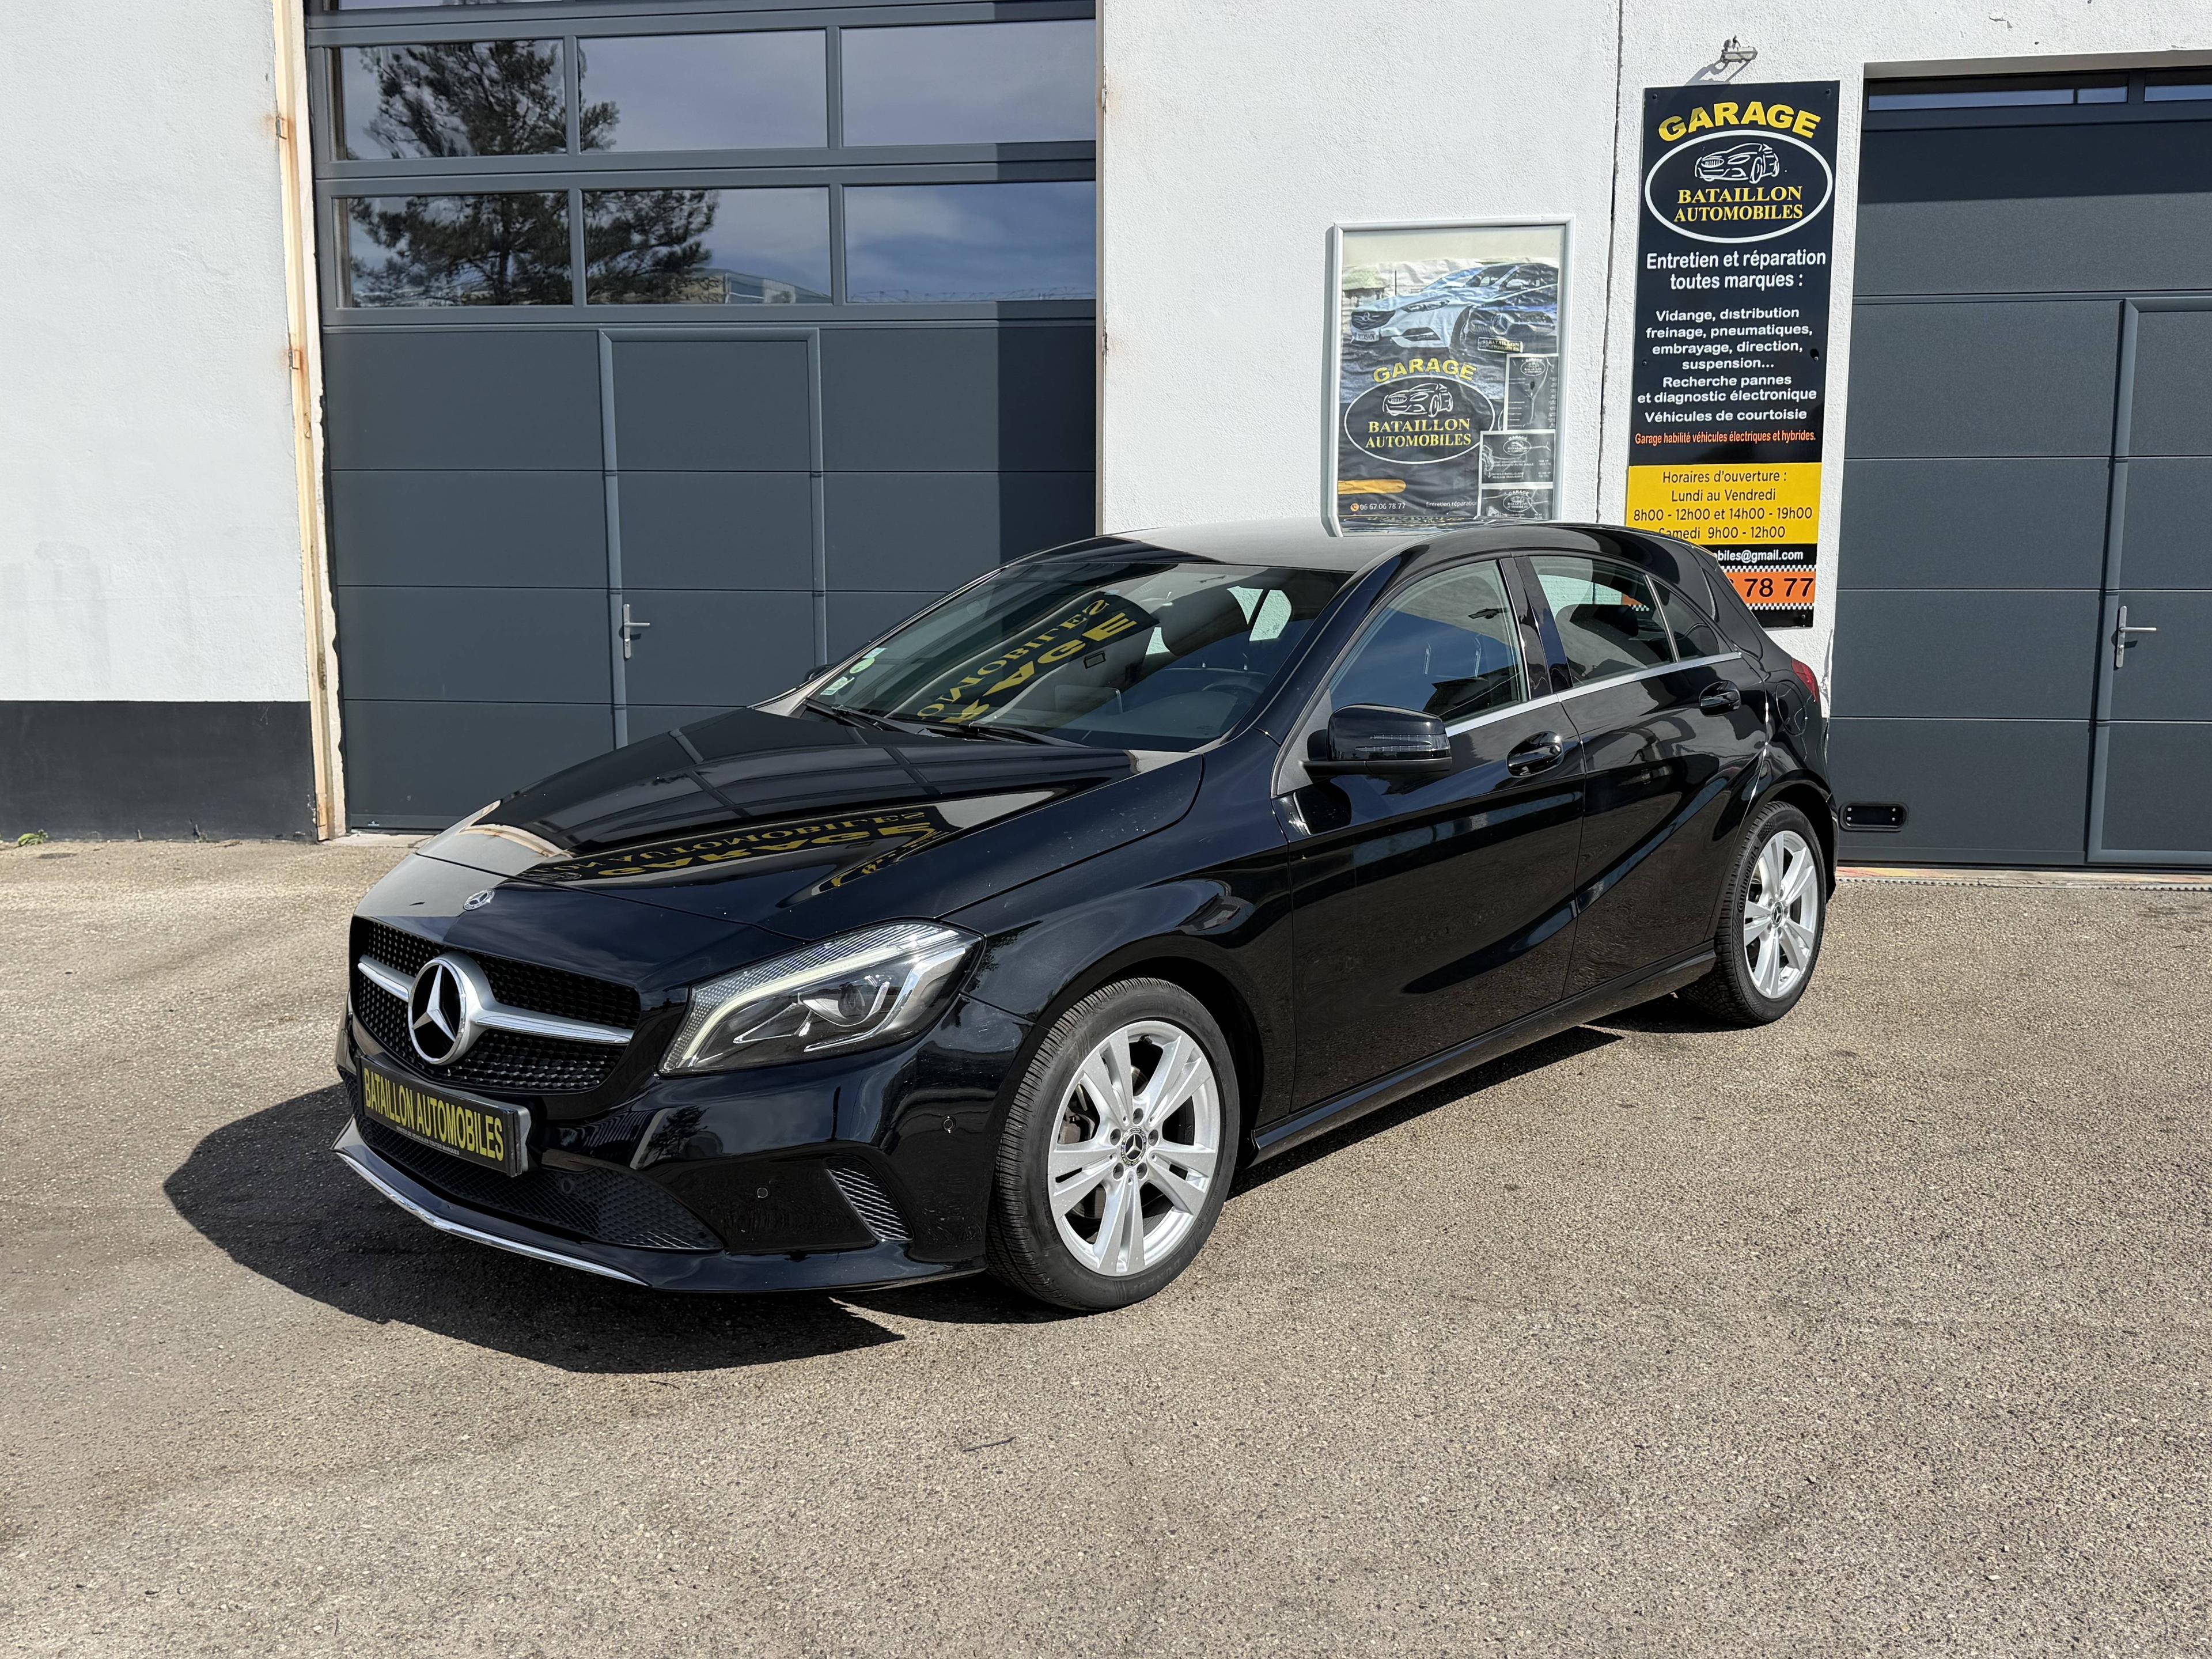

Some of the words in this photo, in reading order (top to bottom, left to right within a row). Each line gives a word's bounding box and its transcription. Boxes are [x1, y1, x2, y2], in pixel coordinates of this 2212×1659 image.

[1658, 101, 1821, 142] GARAGE
[1677, 186, 1803, 204] BATAILLON
[1673, 204, 1803, 222] AUTOMOBILES
[1646, 252, 1719, 270] Entretien
[1723, 251, 1740, 267] et
[1743, 249, 1827, 270] réparation
[1670, 273, 1720, 290] toutes
[1724, 273, 1794, 291] marques
[1656, 310, 1716, 323] Vidange,
[1719, 307, 1800, 320] distribution
[1645, 327, 1707, 340] freinage,
[1710, 324, 1813, 339] pneumatiques,
[1652, 343, 1733, 356] embrayage,
[1736, 340, 1803, 353] direction,
[1373, 358, 1478, 383] GARAGE
[1681, 357, 1775, 372] suspension...
[1662, 376, 1737, 388] Recherche
[1741, 375, 1792, 388] pannes
[1637, 393, 1652, 403] et
[1654, 391, 1727, 405] diagnostic
[1730, 388, 1817, 403] électronique
[1645, 411, 1713, 423] Véhicules
[1716, 410, 1733, 421] de
[1737, 408, 1807, 421] courtoisie
[1368, 419, 1471, 433] BATAILLON
[1365, 434, 1471, 448] AUTOMOBILES
[1635, 433, 1662, 446] Garage
[1664, 431, 1691, 444] habilité
[1692, 431, 1728, 443] véhicules
[1729, 430, 1771, 444] électriques
[1772, 430, 1781, 441] et
[1782, 429, 1816, 443] hybrides.
[1662, 471, 1710, 483] Horaires
[1714, 470, 1780, 483] d'ouverture
[1672, 490, 1703, 502] Lundi
[1707, 492, 1720, 501] au
[1725, 488, 1776, 502] Vendredi
[1634, 509, 1664, 521] 8h00
[1676, 508, 1710, 521] 12h00
[1714, 510, 1725, 520] et
[1729, 507, 1764, 520] 14h00
[1777, 506, 1813, 520] 19h00
[1707, 527, 1738, 539] 9h00
[1751, 526, 1785, 539] 12h00
[1744, 578, 1774, 597] 78
[1783, 578, 1814, 597] 77
[364, 1067, 415, 1130] BATAILLON
[416, 1092, 504, 1162] AUTOMOBILES
